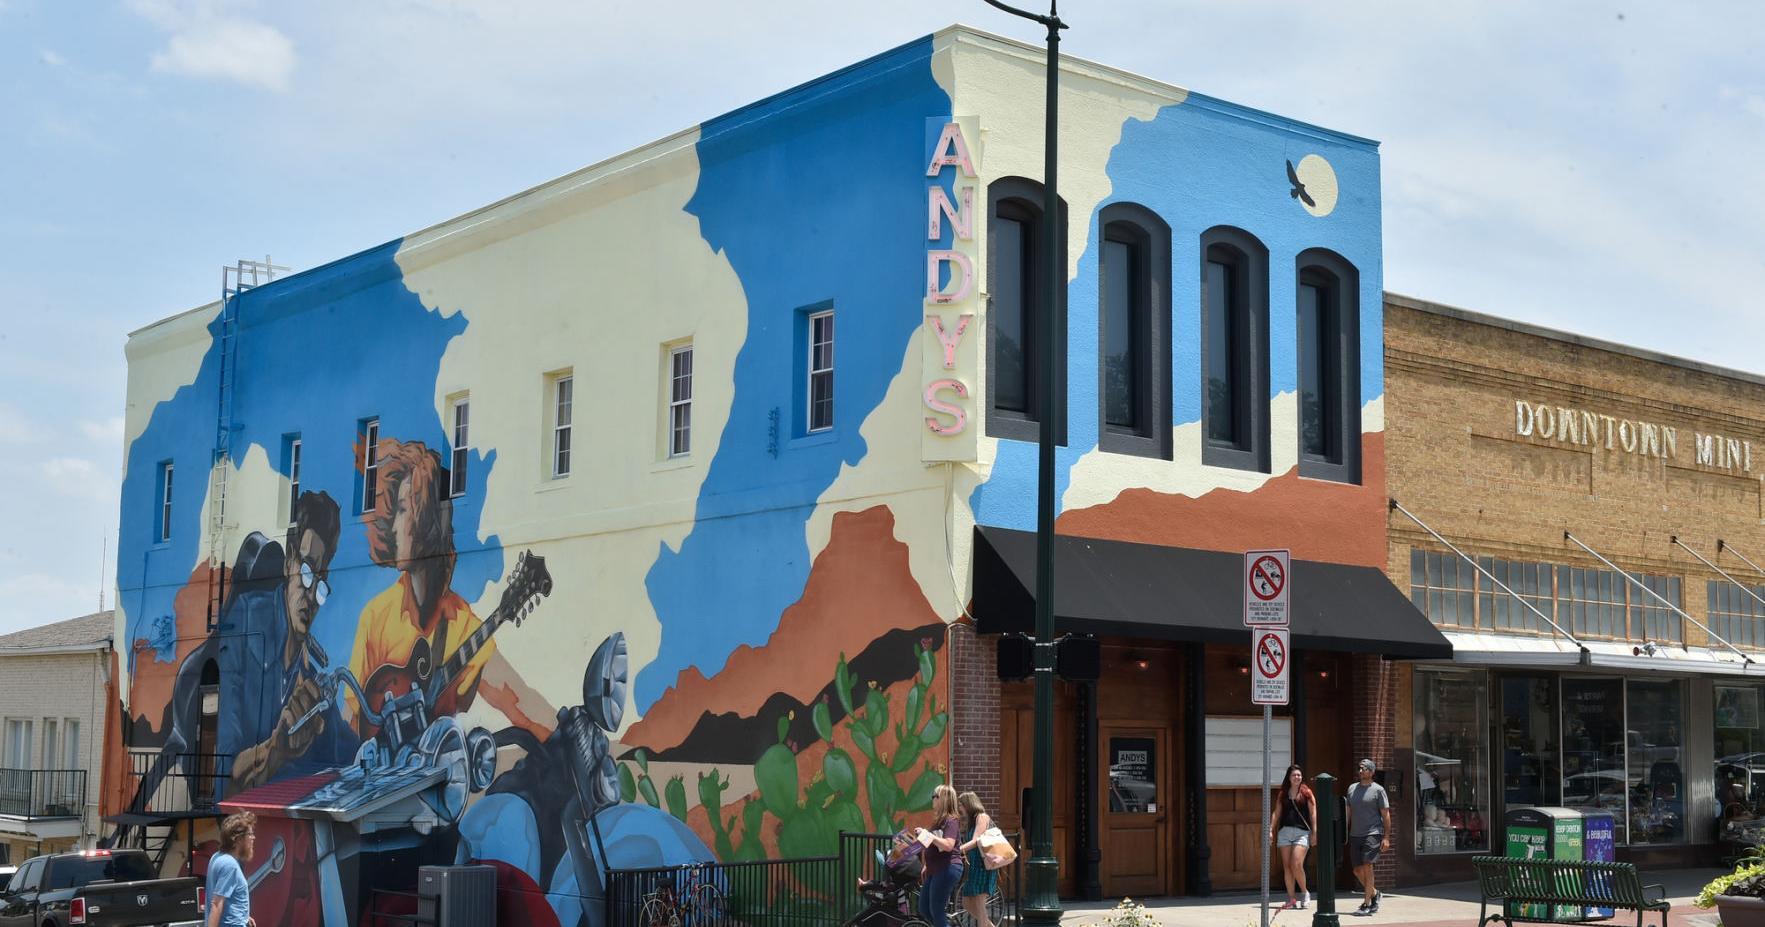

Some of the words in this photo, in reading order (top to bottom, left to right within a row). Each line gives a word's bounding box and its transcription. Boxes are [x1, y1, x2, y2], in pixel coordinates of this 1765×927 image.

[924, 122, 978, 436] ANDYS
[1515, 400, 1677, 459] DOWNTOWN
[1695, 431, 1751, 472] MINI
[1120, 753, 1146, 762] ANDYS
